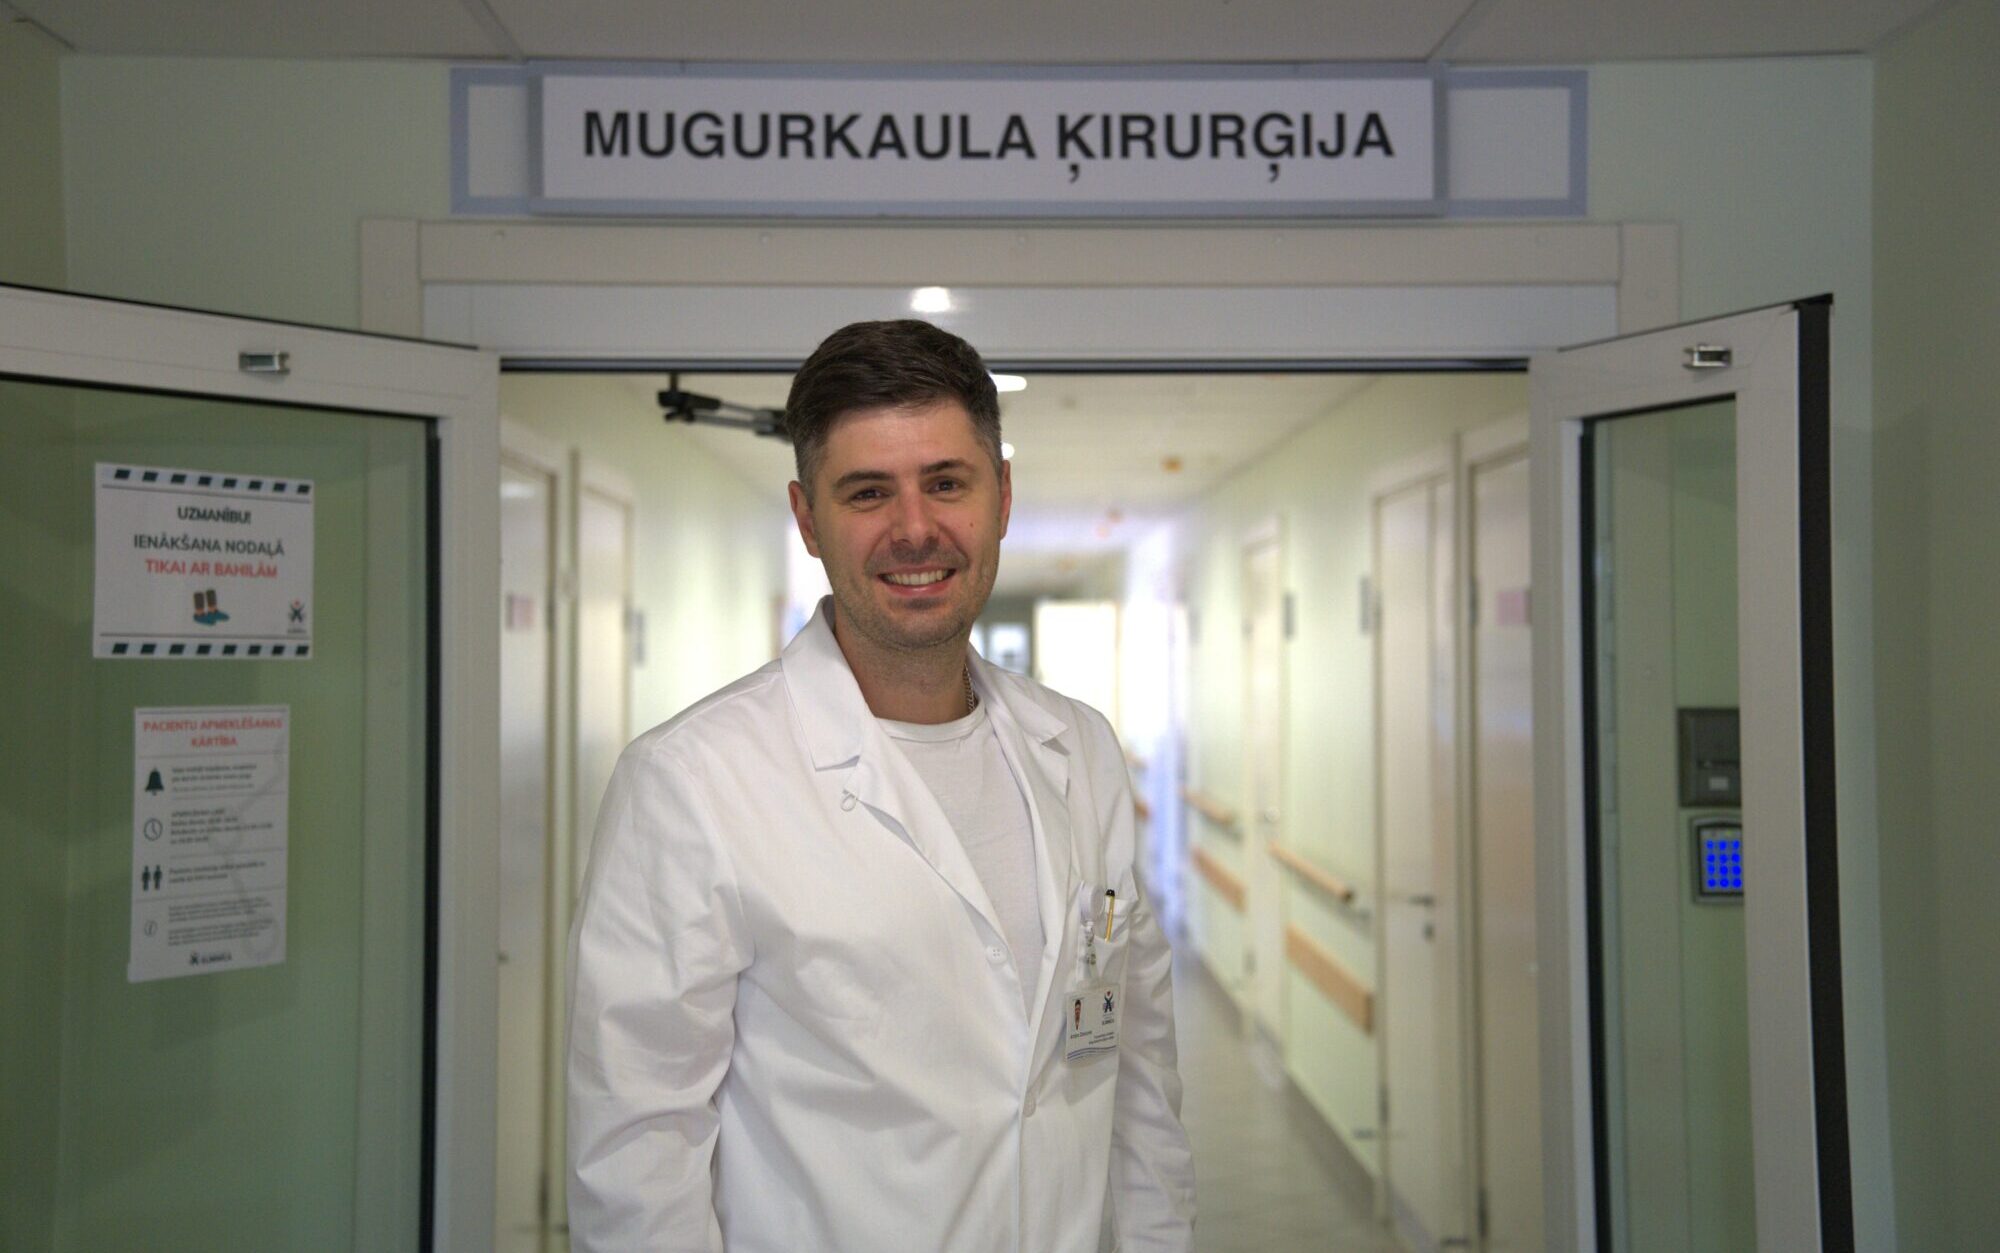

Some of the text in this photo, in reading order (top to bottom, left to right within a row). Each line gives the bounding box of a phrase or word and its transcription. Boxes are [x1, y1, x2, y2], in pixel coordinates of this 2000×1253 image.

[584, 111, 1394, 183] MUGURKAULA ĶIRURĢIJA
[178, 507, 252, 524] UZMANĪBU!
[134, 533, 284, 557] IENĀKŠANA NODAĻĀ
[145, 559, 277, 577] TIKAI AR BAHILĀM
[143, 720, 197, 732] PACIENTU
